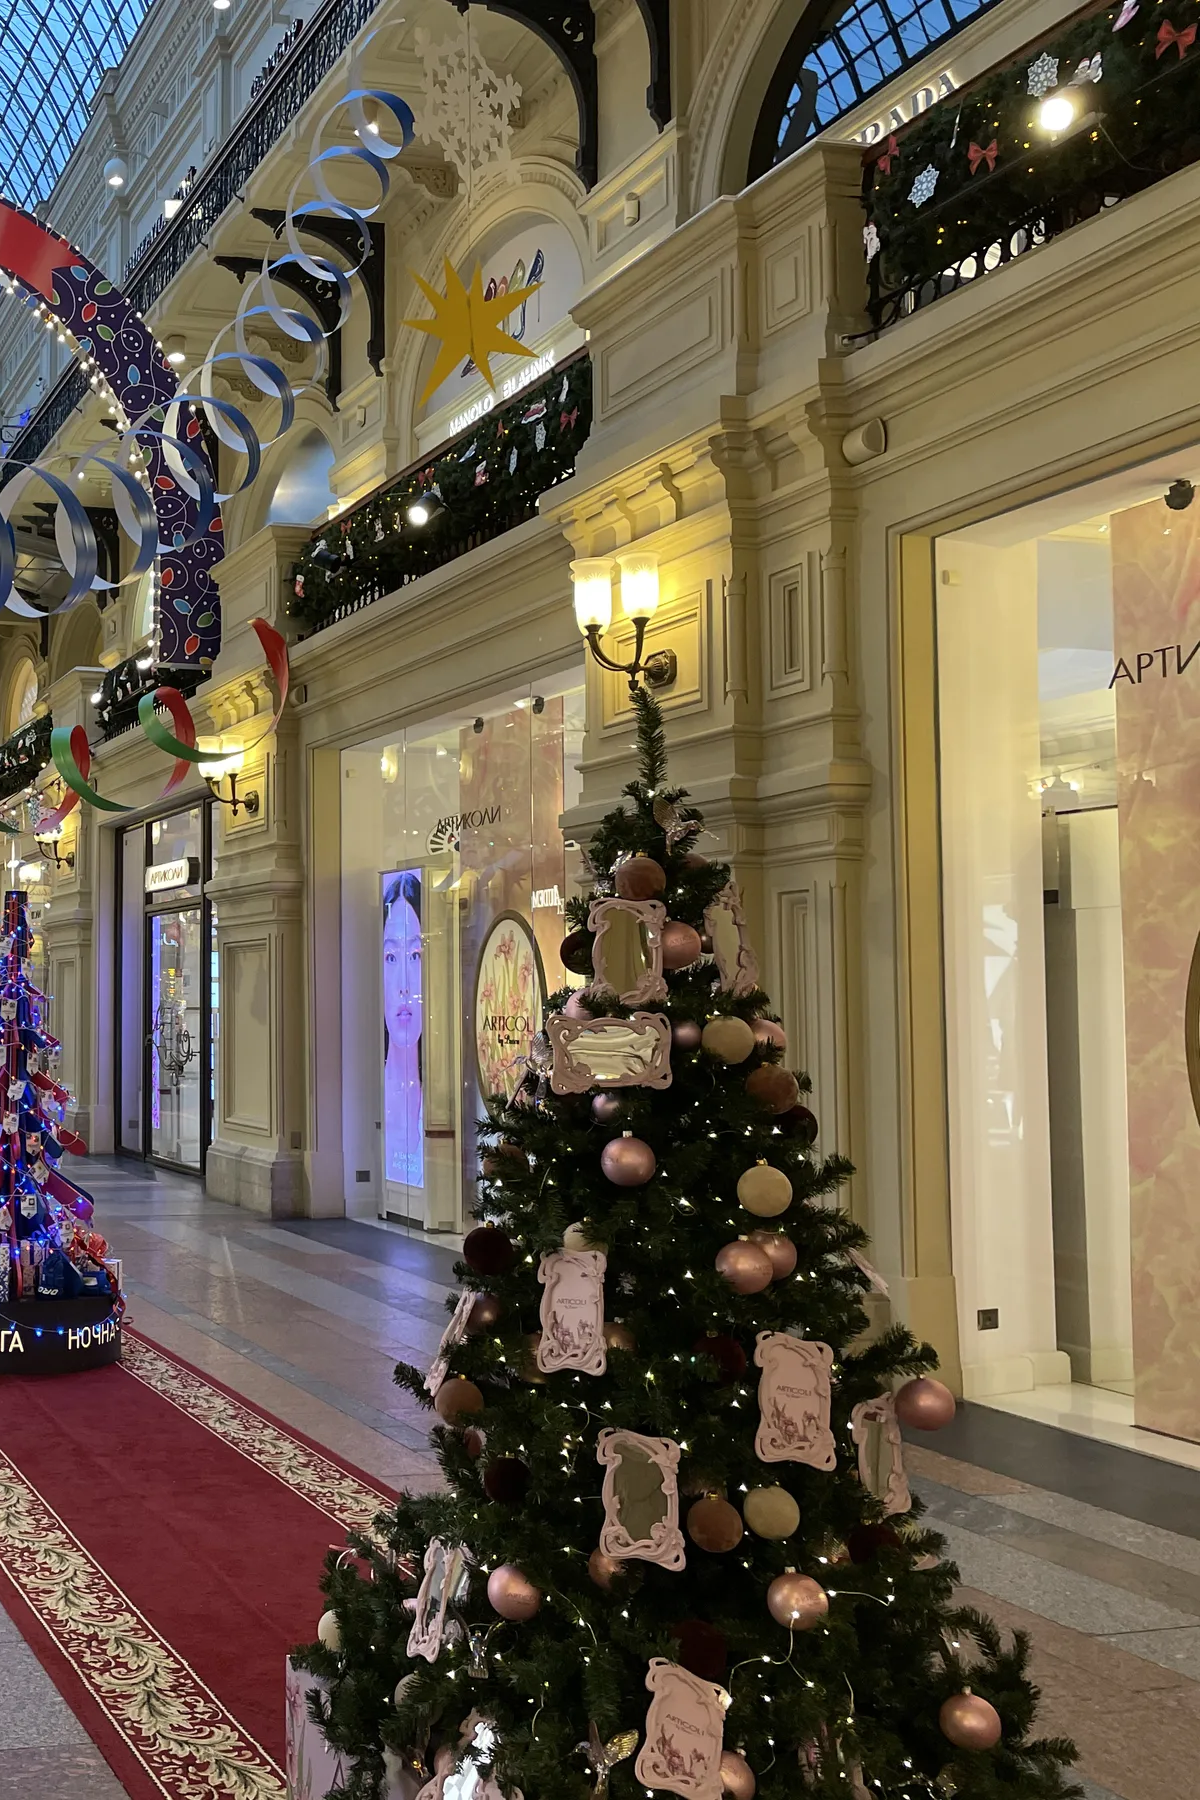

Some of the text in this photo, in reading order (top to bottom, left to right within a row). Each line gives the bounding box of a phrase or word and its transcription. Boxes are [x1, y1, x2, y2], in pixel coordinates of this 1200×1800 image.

[448, 349, 556, 436] MANOLO BLAHNIK
[436, 804, 502, 836] АРТИКОЛИ
[150, 865, 184, 886] АРТИКОЛИ
[665, 1713, 705, 1737] ARTICOLI
